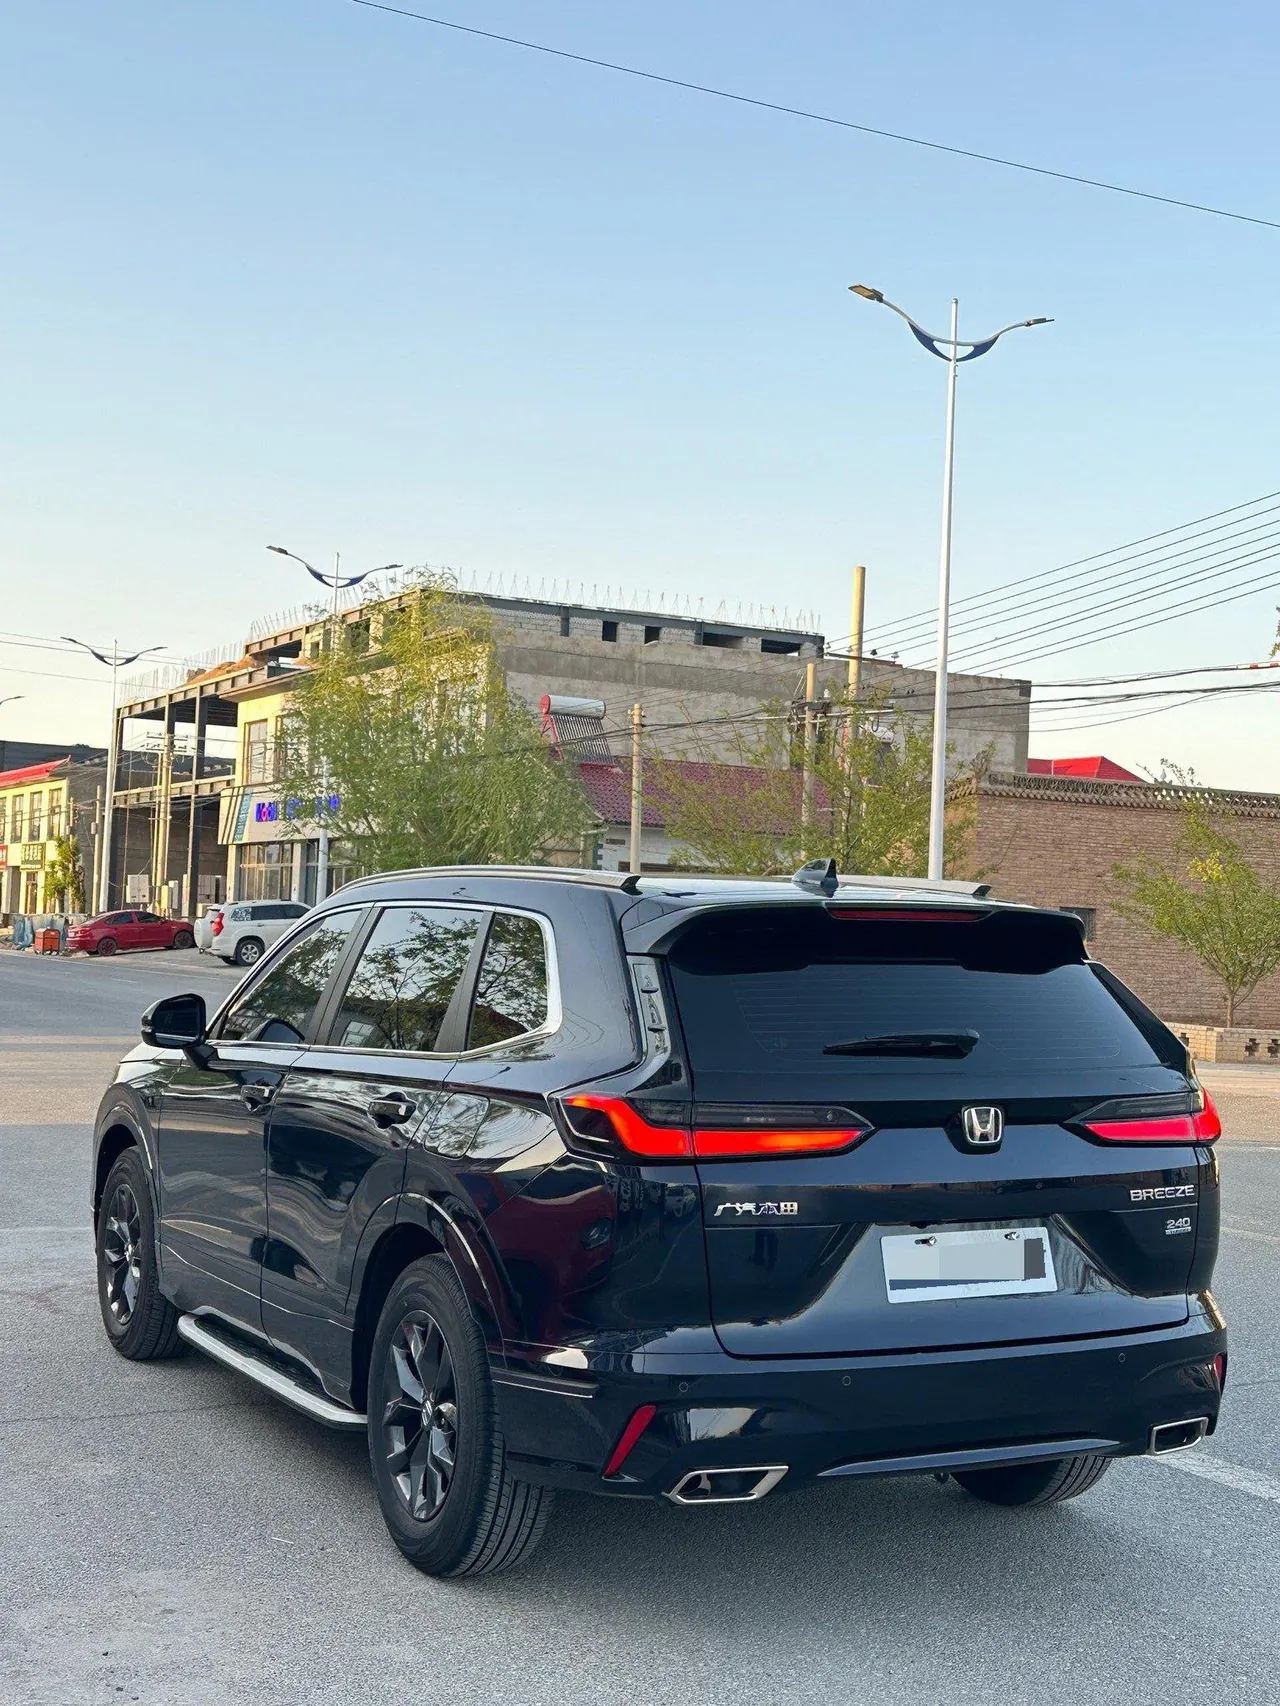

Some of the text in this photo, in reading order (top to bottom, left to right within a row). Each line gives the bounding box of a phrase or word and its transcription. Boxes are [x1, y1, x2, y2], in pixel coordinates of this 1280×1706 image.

[1130, 1185, 1194, 1201] BREEZE
[714, 1202, 798, 1216] 广汽本田
[1166, 1217, 1191, 1229] 240
